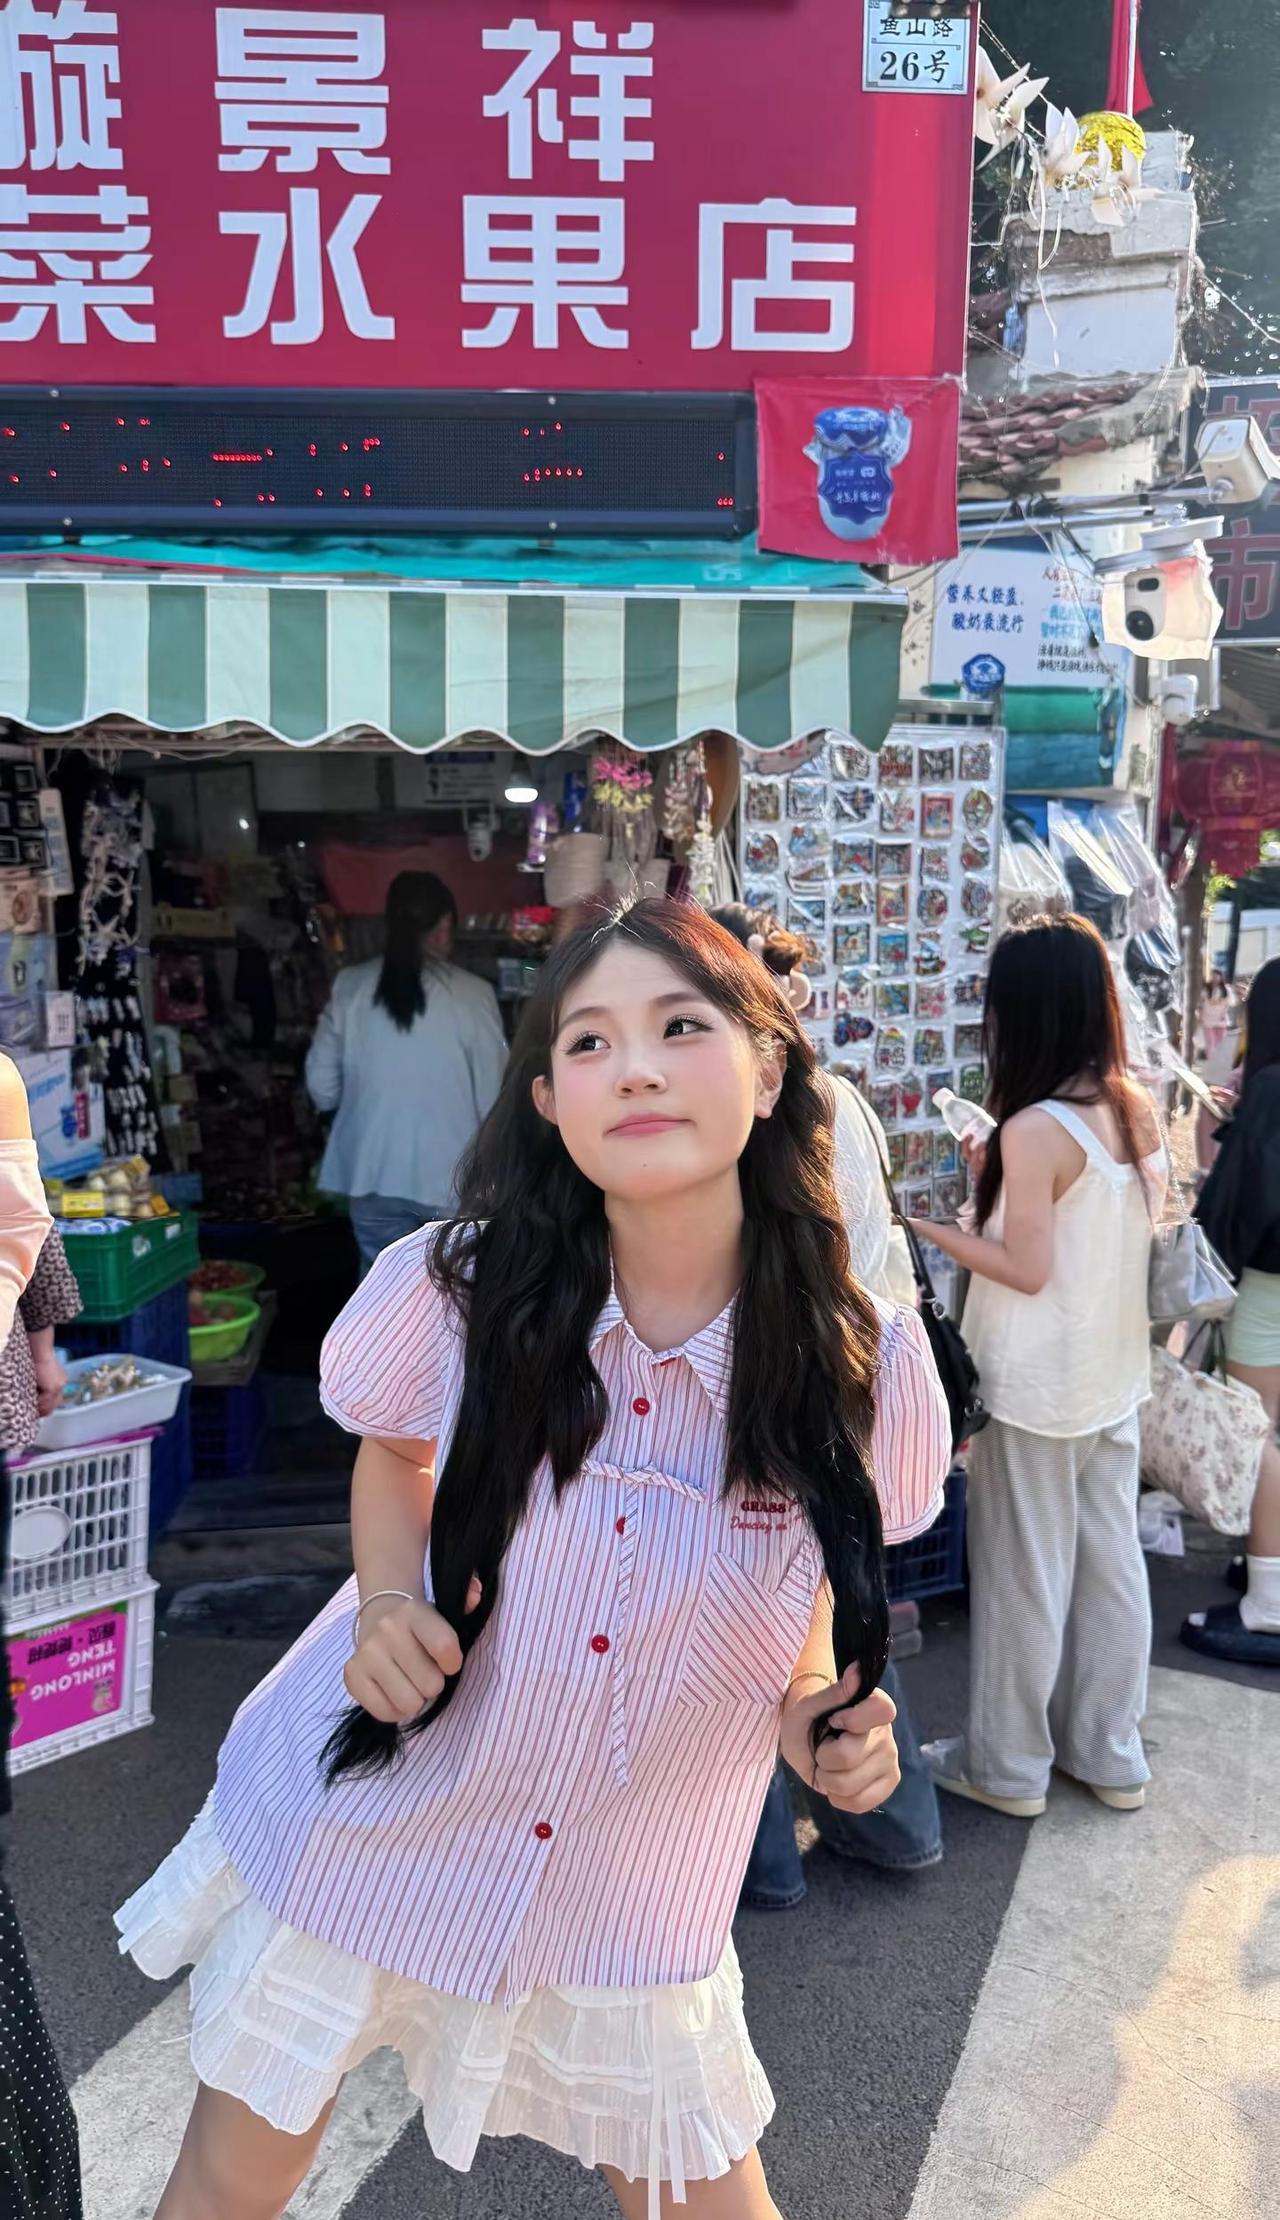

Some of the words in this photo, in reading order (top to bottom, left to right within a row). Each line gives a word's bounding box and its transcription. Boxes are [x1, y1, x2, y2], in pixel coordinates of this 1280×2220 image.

[880, 49, 950, 83] 26号
[0, 183, 859, 352] 菜水果店
[67, 1640, 116, 1668] TENG
[30, 1659, 116, 1701] MINLONG
